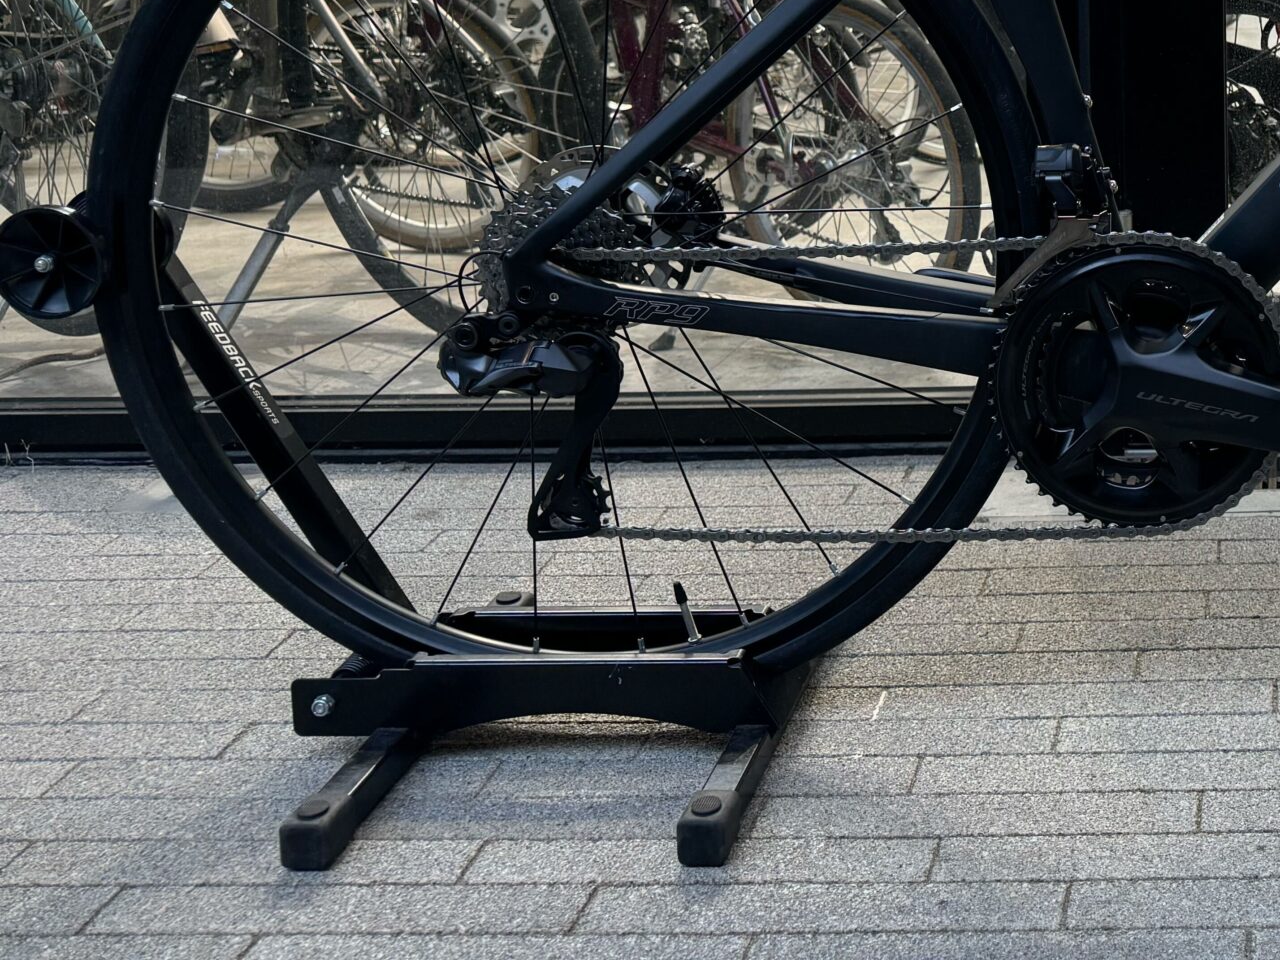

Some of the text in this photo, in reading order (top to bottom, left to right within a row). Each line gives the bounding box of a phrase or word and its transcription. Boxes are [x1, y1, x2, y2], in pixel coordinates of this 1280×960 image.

[602, 296, 711, 326] RP9
[192, 300, 262, 390] FEEDBACK
[1136, 391, 1260, 424] ULTEGRA
